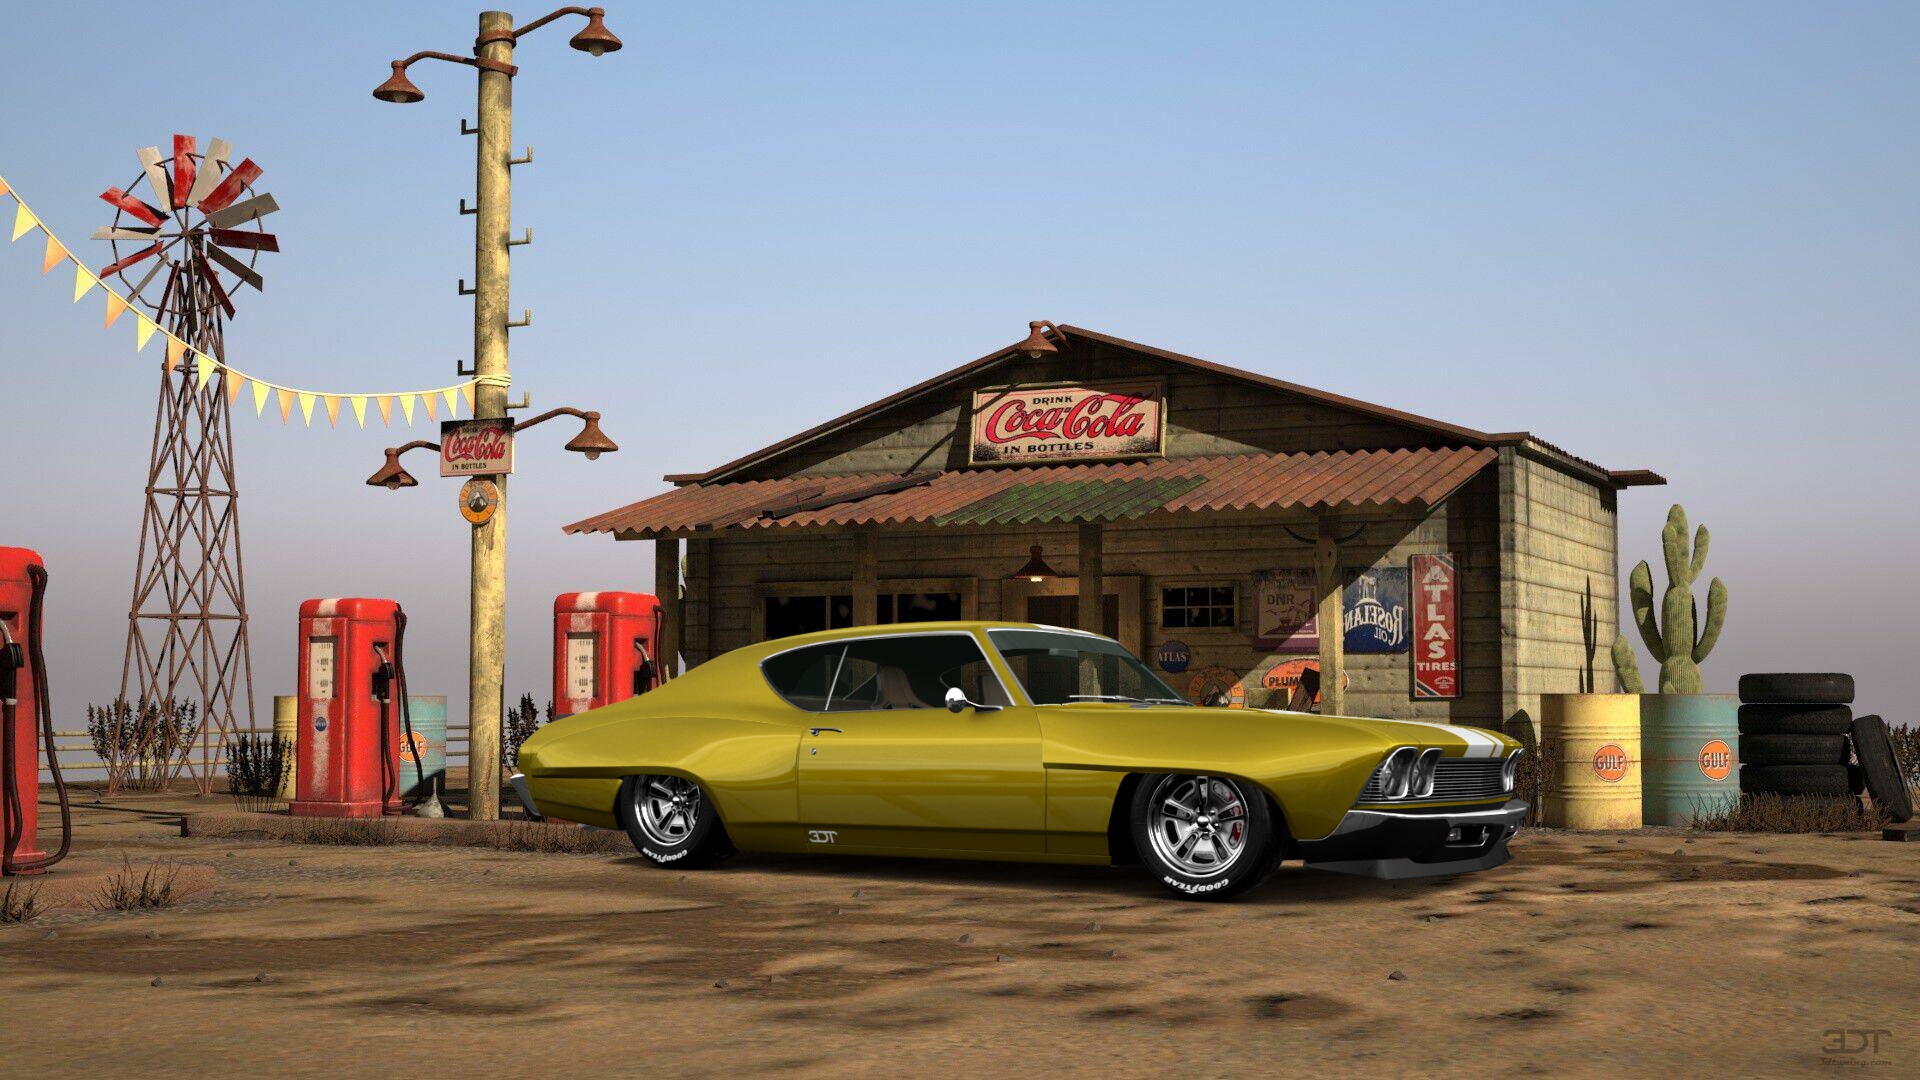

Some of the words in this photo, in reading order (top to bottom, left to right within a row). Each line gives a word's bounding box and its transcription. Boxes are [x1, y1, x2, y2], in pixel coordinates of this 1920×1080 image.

[1033, 395, 1073, 406] DRINK
[985, 392, 1152, 444] Coca-Cola
[445, 427, 506, 462] Coca-Cola
[1004, 445, 1021, 454] IN
[1028, 441, 1094, 453] BOTTLES
[461, 462, 487, 470] BOTTLES
[1422, 565, 1451, 660] ATLAS
[1158, 651, 1187, 662] ATLAS
[1417, 662, 1457, 671] TIRES
[1269, 677, 1301, 687] PLUM
[1596, 755, 1624, 769] GULF
[1702, 753, 1729, 768] GULF
[809, 830, 838, 843] 3DT
[1163, 875, 1230, 894] GOODYEAR
